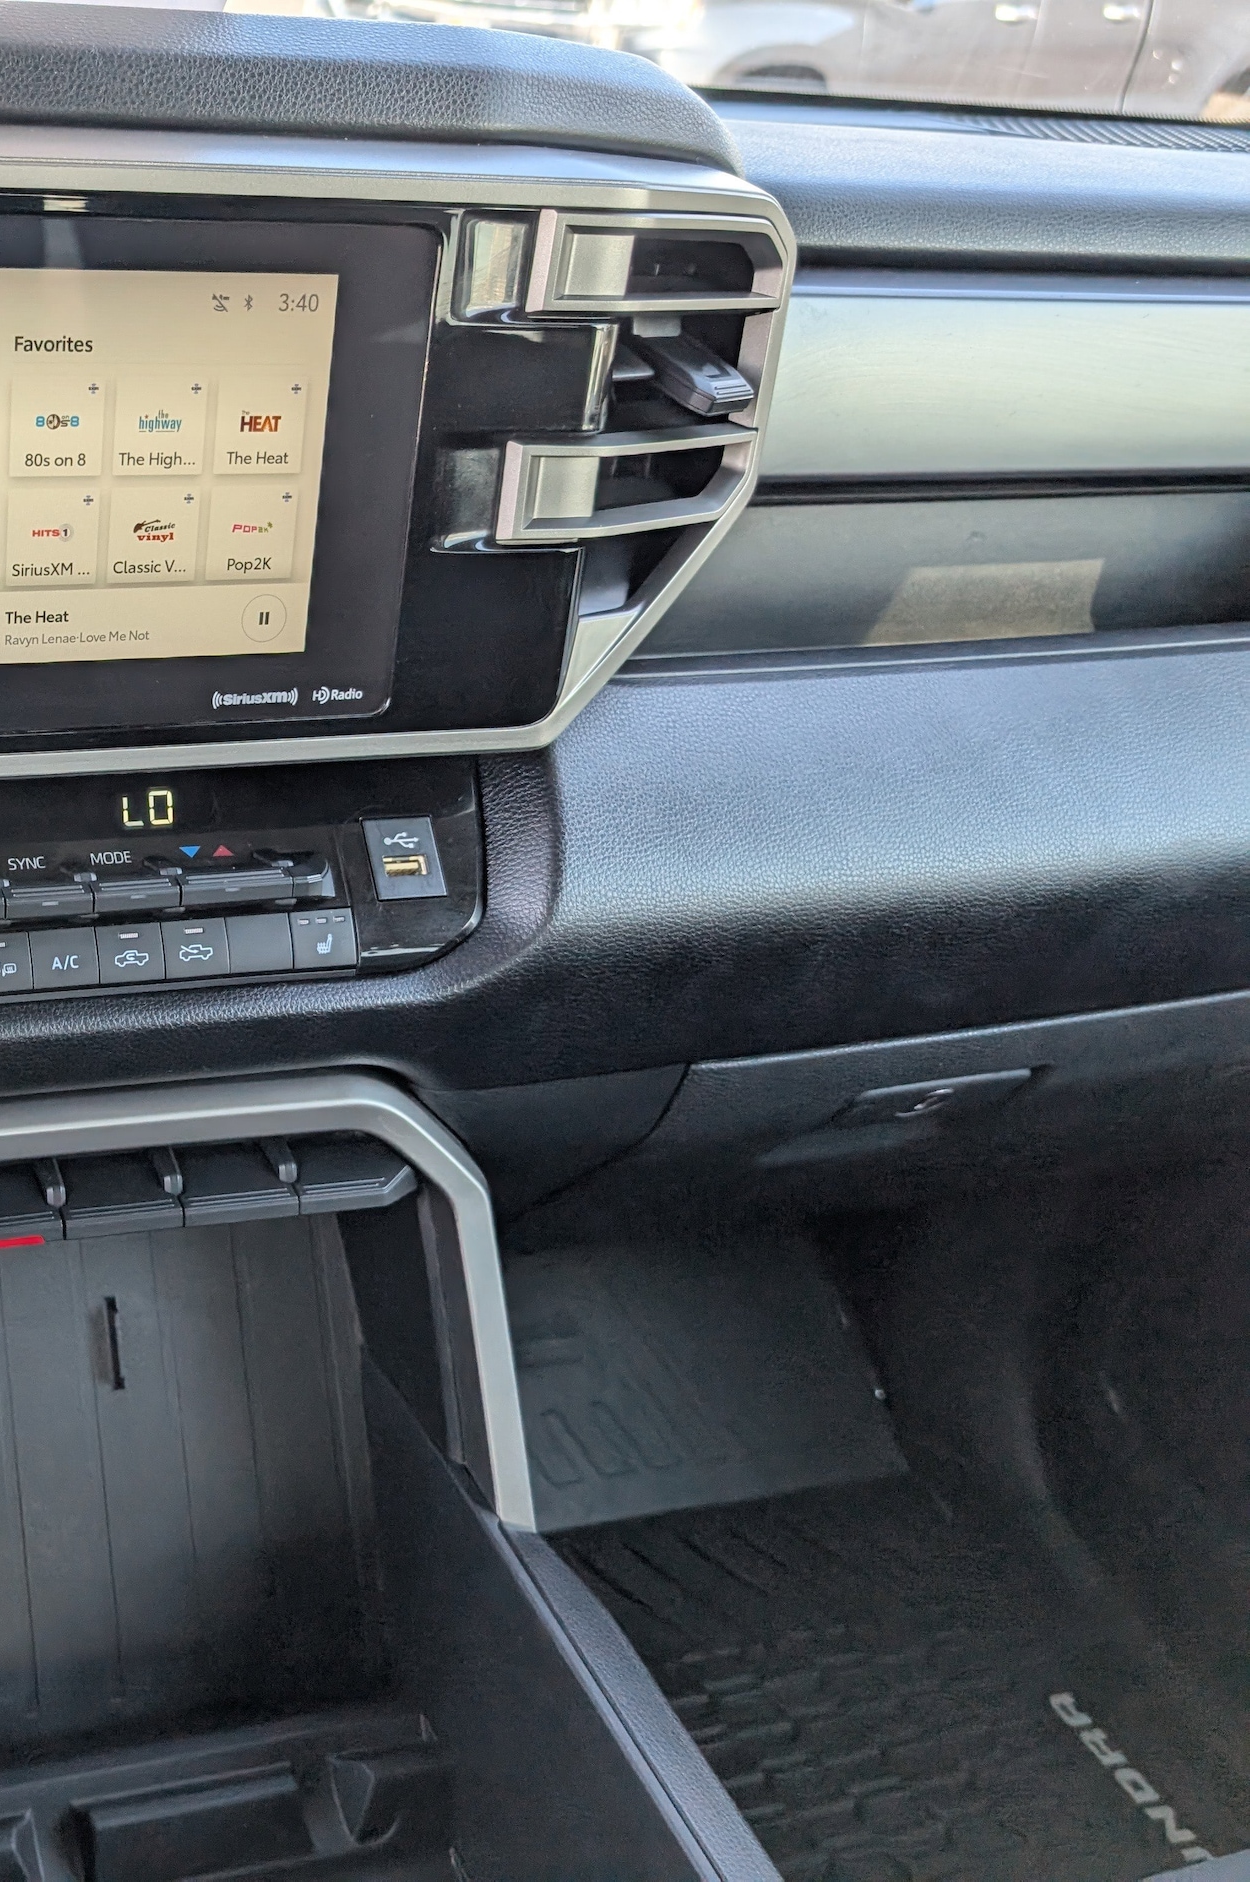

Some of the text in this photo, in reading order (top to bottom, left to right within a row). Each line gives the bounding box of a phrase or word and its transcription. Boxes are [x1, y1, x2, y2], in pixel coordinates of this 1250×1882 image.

[278, 293, 319, 312] 3:40
[13, 336, 93, 353] Favorites
[139, 416, 182, 433] highway
[240, 416, 282, 432] HEAT
[24, 453, 86, 467] 80s on 8
[119, 452, 196, 470] The High...
[227, 451, 288, 465] The Heat
[32, 529, 59, 537] HITS
[144, 523, 175, 533] Classic
[137, 533, 174, 542] vinyl
[11, 563, 73, 577] SiriusXM
[113, 560, 161, 574] Classic
[226, 557, 271, 573] Pop2K
[5, 610, 69, 624] The Heat
[5, 634, 39, 646] Ravyn
[108, 632, 126, 642] Me
[130, 630, 150, 641] Not
[331, 688, 363, 700] Radio
[7, 856, 46, 871] SYNC
[90, 850, 132, 866] MODE
[52, 955, 79, 971] A/C
